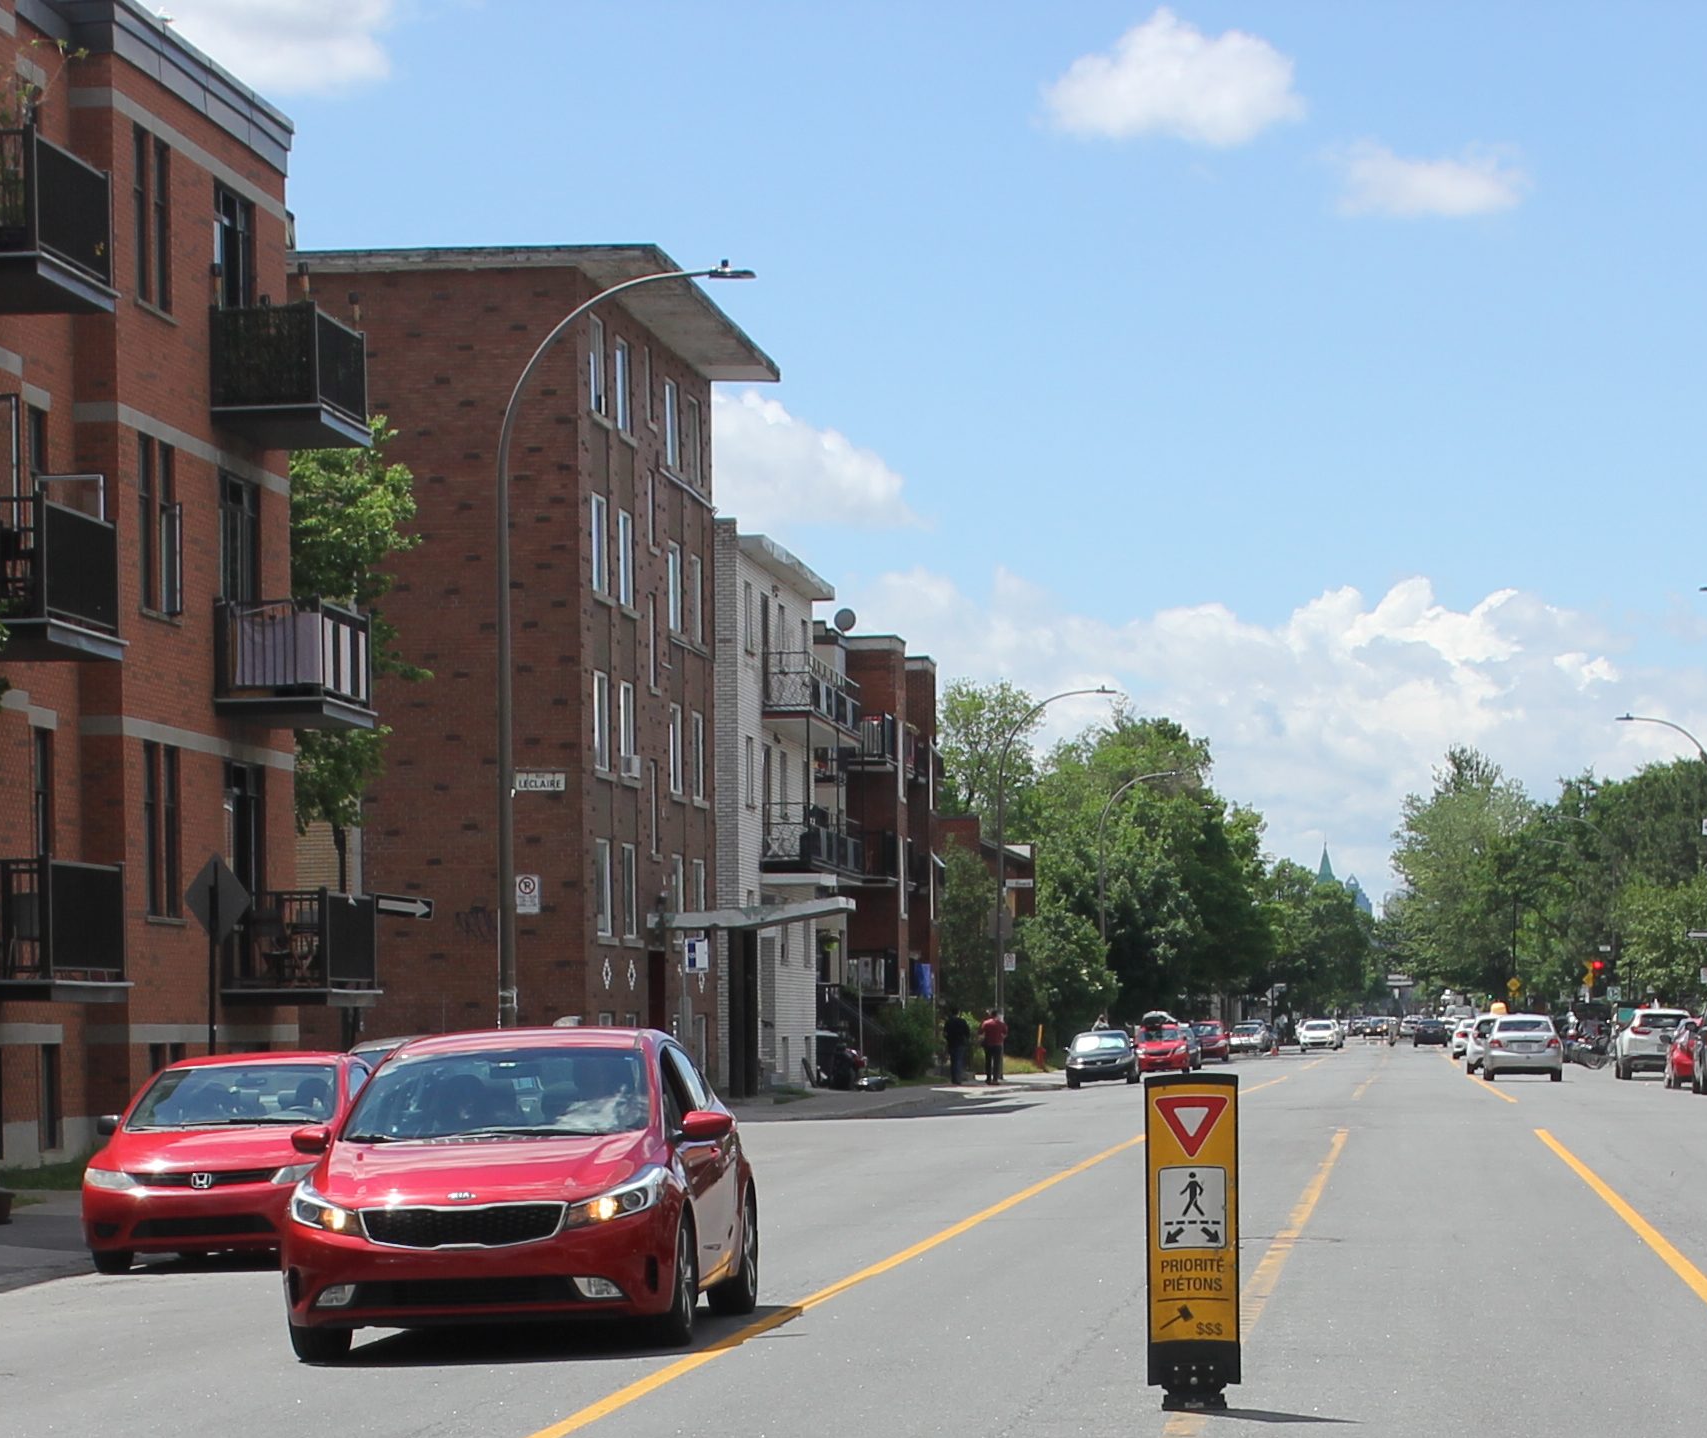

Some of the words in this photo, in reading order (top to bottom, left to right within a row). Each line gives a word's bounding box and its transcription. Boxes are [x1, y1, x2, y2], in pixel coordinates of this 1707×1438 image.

[518, 779, 562, 789] LECLAIRE
[1160, 1256, 1225, 1274] PRIORITÉ
[1162, 1274, 1223, 1292] PIÉTONS
[1196, 1321, 1223, 1336] $$$
